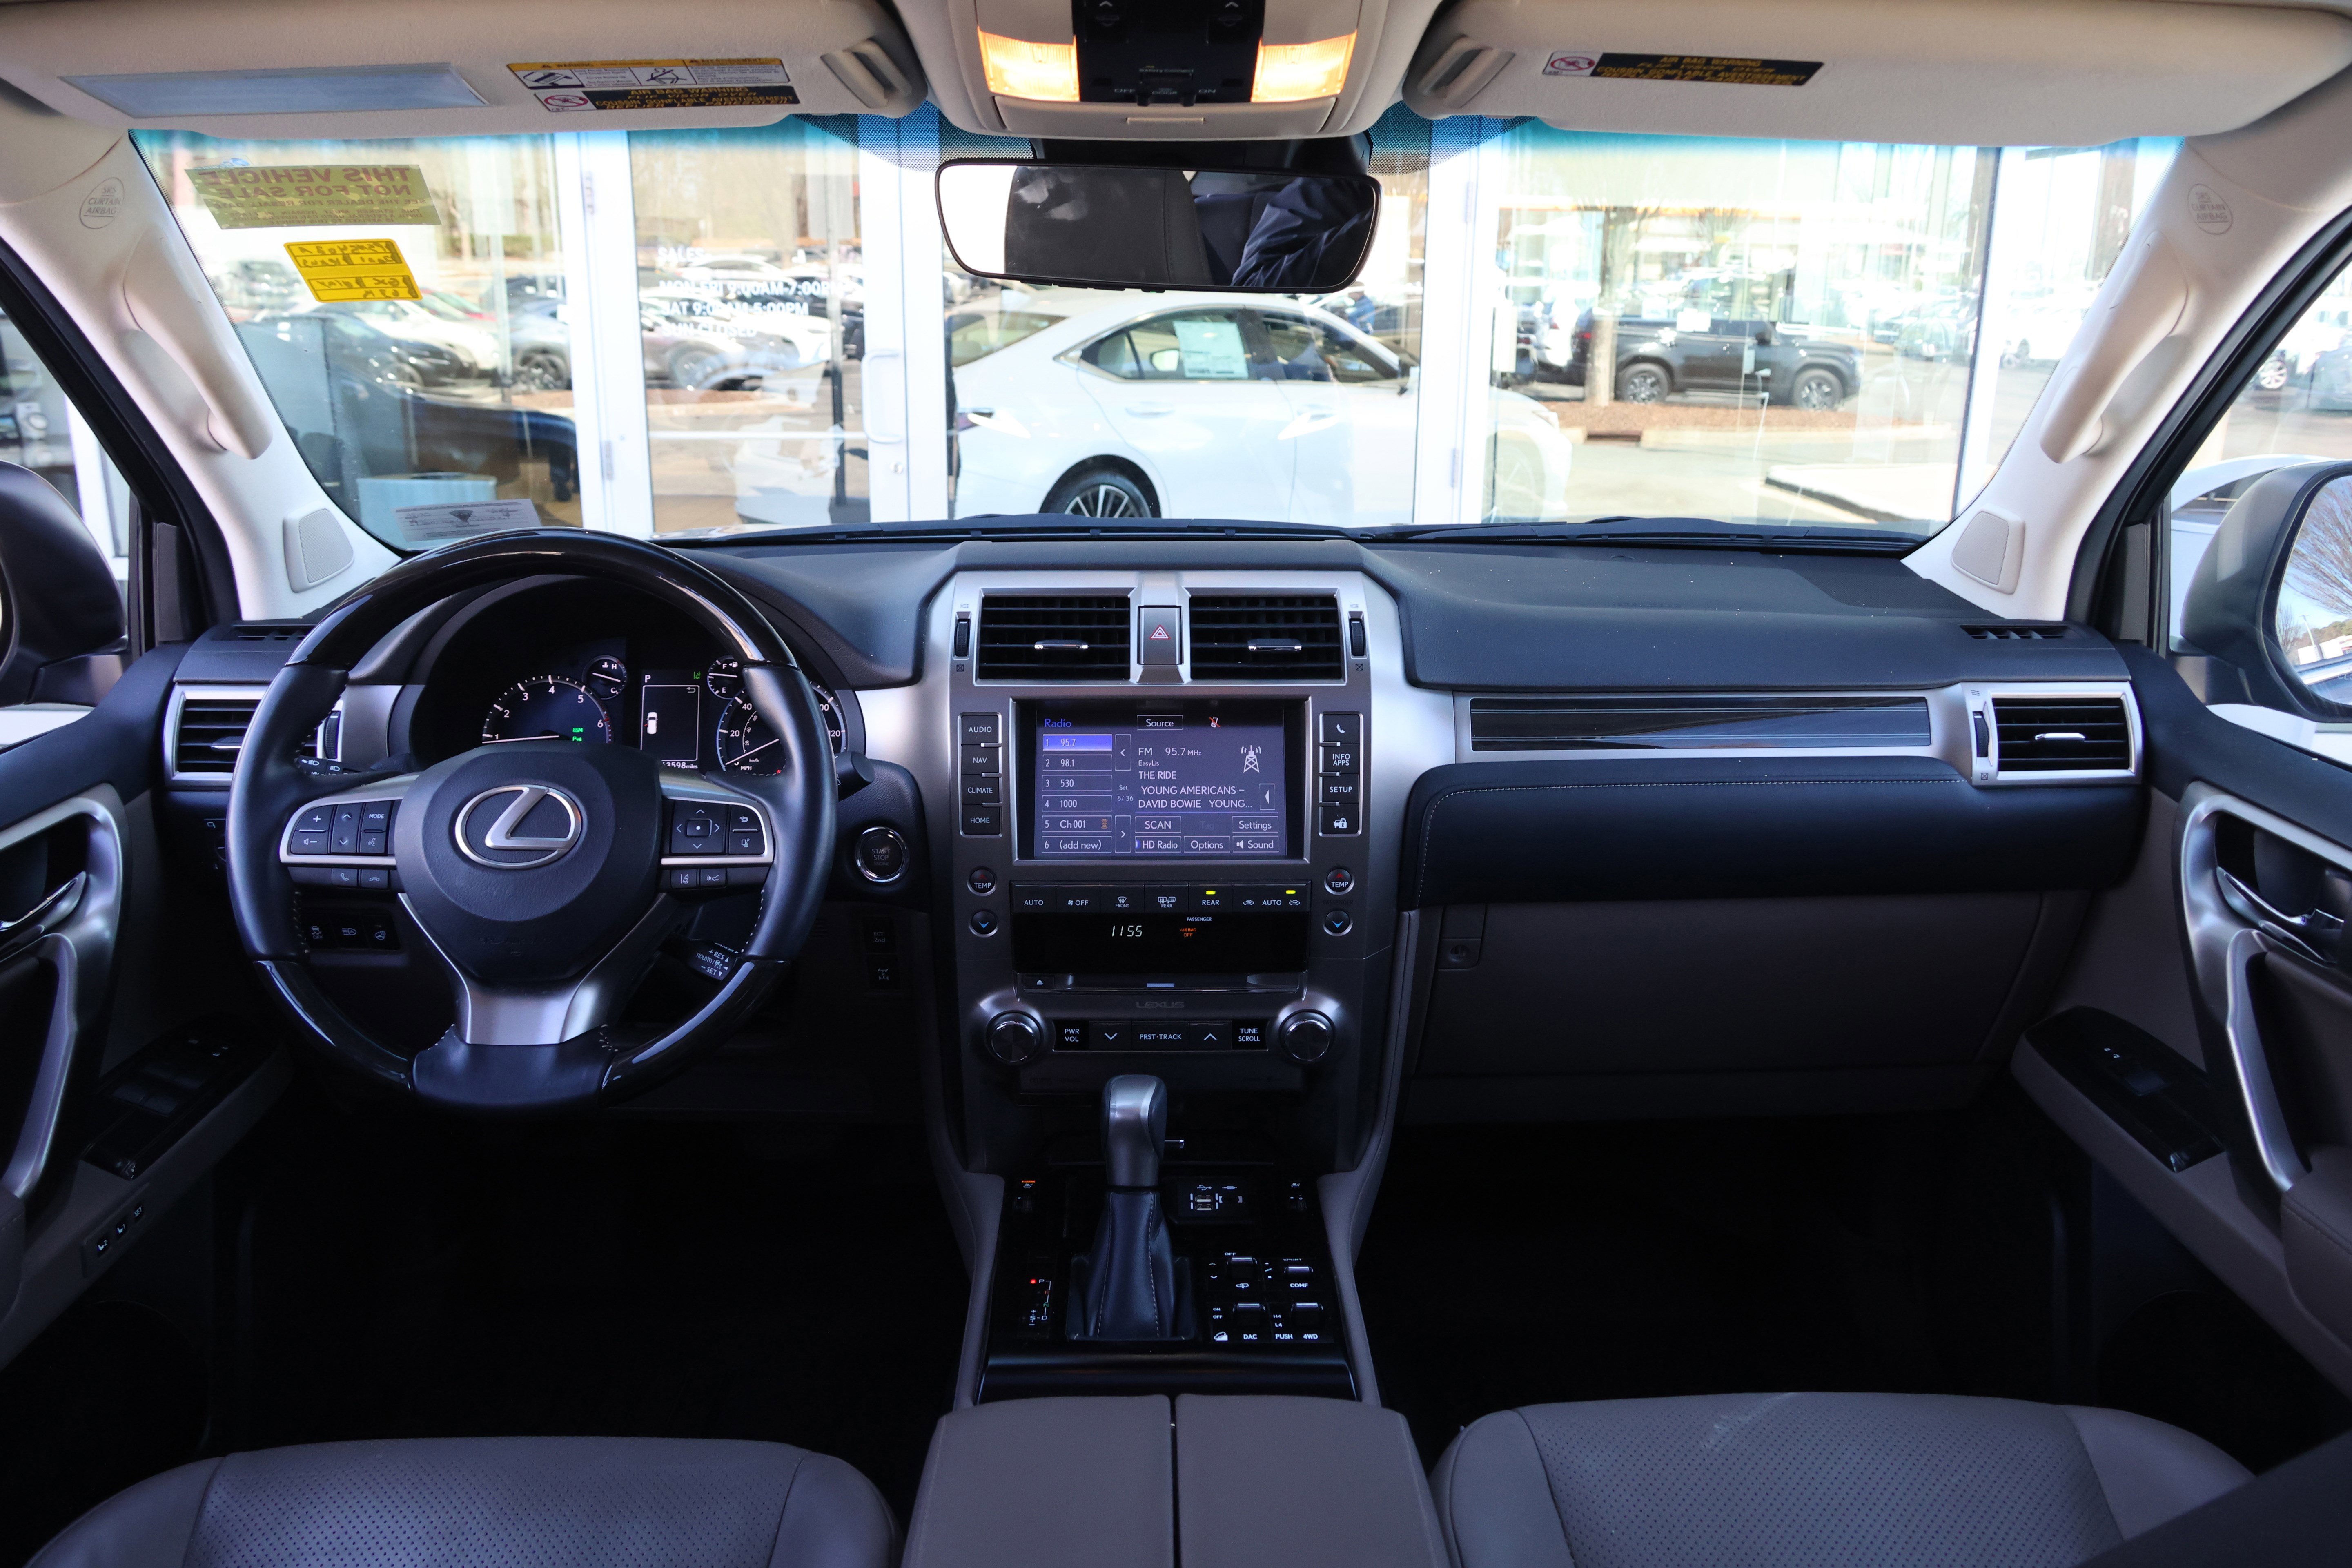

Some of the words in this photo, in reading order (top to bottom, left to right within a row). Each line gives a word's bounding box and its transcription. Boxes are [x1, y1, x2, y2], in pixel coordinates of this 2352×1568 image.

[644, 675, 651, 683] P
[548, 686, 555, 694] 4
[522, 692, 529, 701] 3
[577, 695, 584, 704] 5
[503, 709, 510, 718] 2
[597, 719, 604, 728] 6
[1044, 718, 1072, 728] Radio
[1145, 719, 1174, 728] Source
[1045, 738, 1049, 746] 1
[1060, 738, 1076, 746] 95.7
[1138, 747, 1153, 756] FM
[1165, 747, 1186, 756] 95.7
[662, 761, 686, 769] 3598
[1045, 759, 1050, 767] 2
[1060, 759, 1075, 767] 98.1
[1138, 771, 1155, 780] THE
[1157, 771, 1177, 780] RIDE
[1045, 779, 1050, 788] 3
[1060, 779, 1074, 788] 530
[1141, 786, 1178, 795] YOUNG
[1179, 786, 1236, 795] AMERICANS
[1045, 800, 1049, 808] 4
[1060, 800, 1078, 808] 1000
[1138, 799, 1168, 808] DAVID
[1170, 799, 1202, 808] BOWIE
[1208, 799, 1253, 808] YOUNG...
[1045, 820, 1049, 829] 5
[1145, 821, 1172, 829] SCAN
[1238, 820, 1272, 831] Settings
[1044, 841, 1049, 849] 6
[1059, 839, 1078, 850] (add
[1081, 839, 1102, 850] new)
[1143, 840, 1155, 849] HD
[1157, 840, 1178, 849] Radio
[1190, 840, 1223, 851] Options
[1247, 840, 1274, 849] Sound
[696, 953, 708, 961] HOLD
[713, 951, 725, 960] RES
[706, 967, 717, 976] SET
